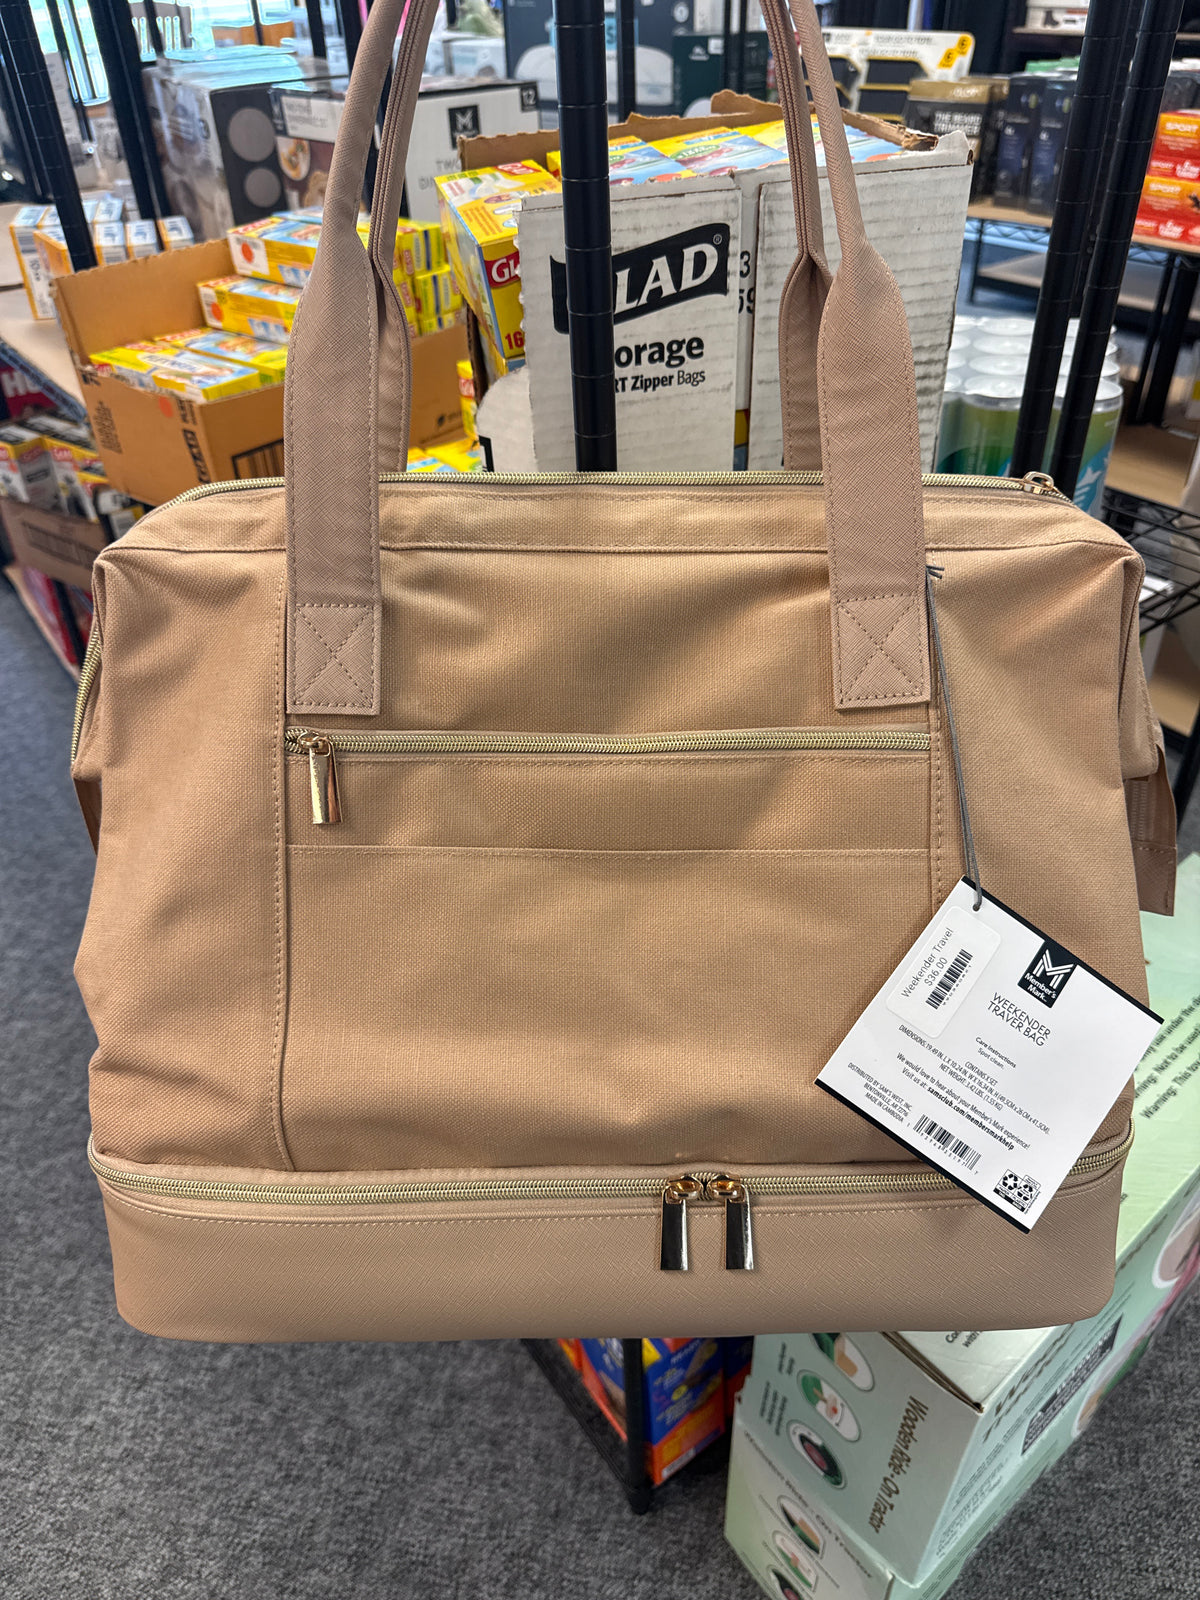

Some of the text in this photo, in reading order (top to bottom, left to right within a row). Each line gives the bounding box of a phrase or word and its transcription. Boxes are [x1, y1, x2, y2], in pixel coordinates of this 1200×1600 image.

[614, 243, 719, 315] LAD
[614, 336, 705, 369] orage
[631, 373, 674, 392] Zipper
[677, 370, 706, 387] Bags
[900, 927, 954, 998] Weekender Travel
[923, 957, 948, 987] $36.00
[1024, 972, 1057, 999] Member's
[1027, 983, 1046, 1001] Mark
[987, 1000, 1046, 1047] TRAVER BAG
[993, 991, 1051, 1038] WEEKENDER
[938, 1062, 951, 1073] NET
[975, 1036, 1017, 1069] Care Instructions
[977, 1047, 1004, 1070] Spot clean.
[964, 1061, 988, 1080] CONTAINS
[987, 1077, 999, 1087] SET
[896, 1052, 906, 1063] We
[904, 1059, 922, 1073] would
[919, 1068, 931, 1080] love
[929, 1076, 936, 1084] to
[934, 1079, 947, 1092] hear
[945, 1088, 961, 1102] about
[957, 1098, 971, 1109] your
[969, 1104, 993, 1125] Member's
[991, 1119, 1005, 1133] Mark
[901, 1066, 915, 1080] Visit
[912, 1076, 921, 1084] us
[927, 1086, 1015, 1151] samsclub.com/membersmarkhelp
[895, 1395, 929, 1450] Wooden
[888, 1444, 911, 1475] Ride
[879, 1476, 900, 1499] On
[868, 1492, 895, 1534] Tractor
